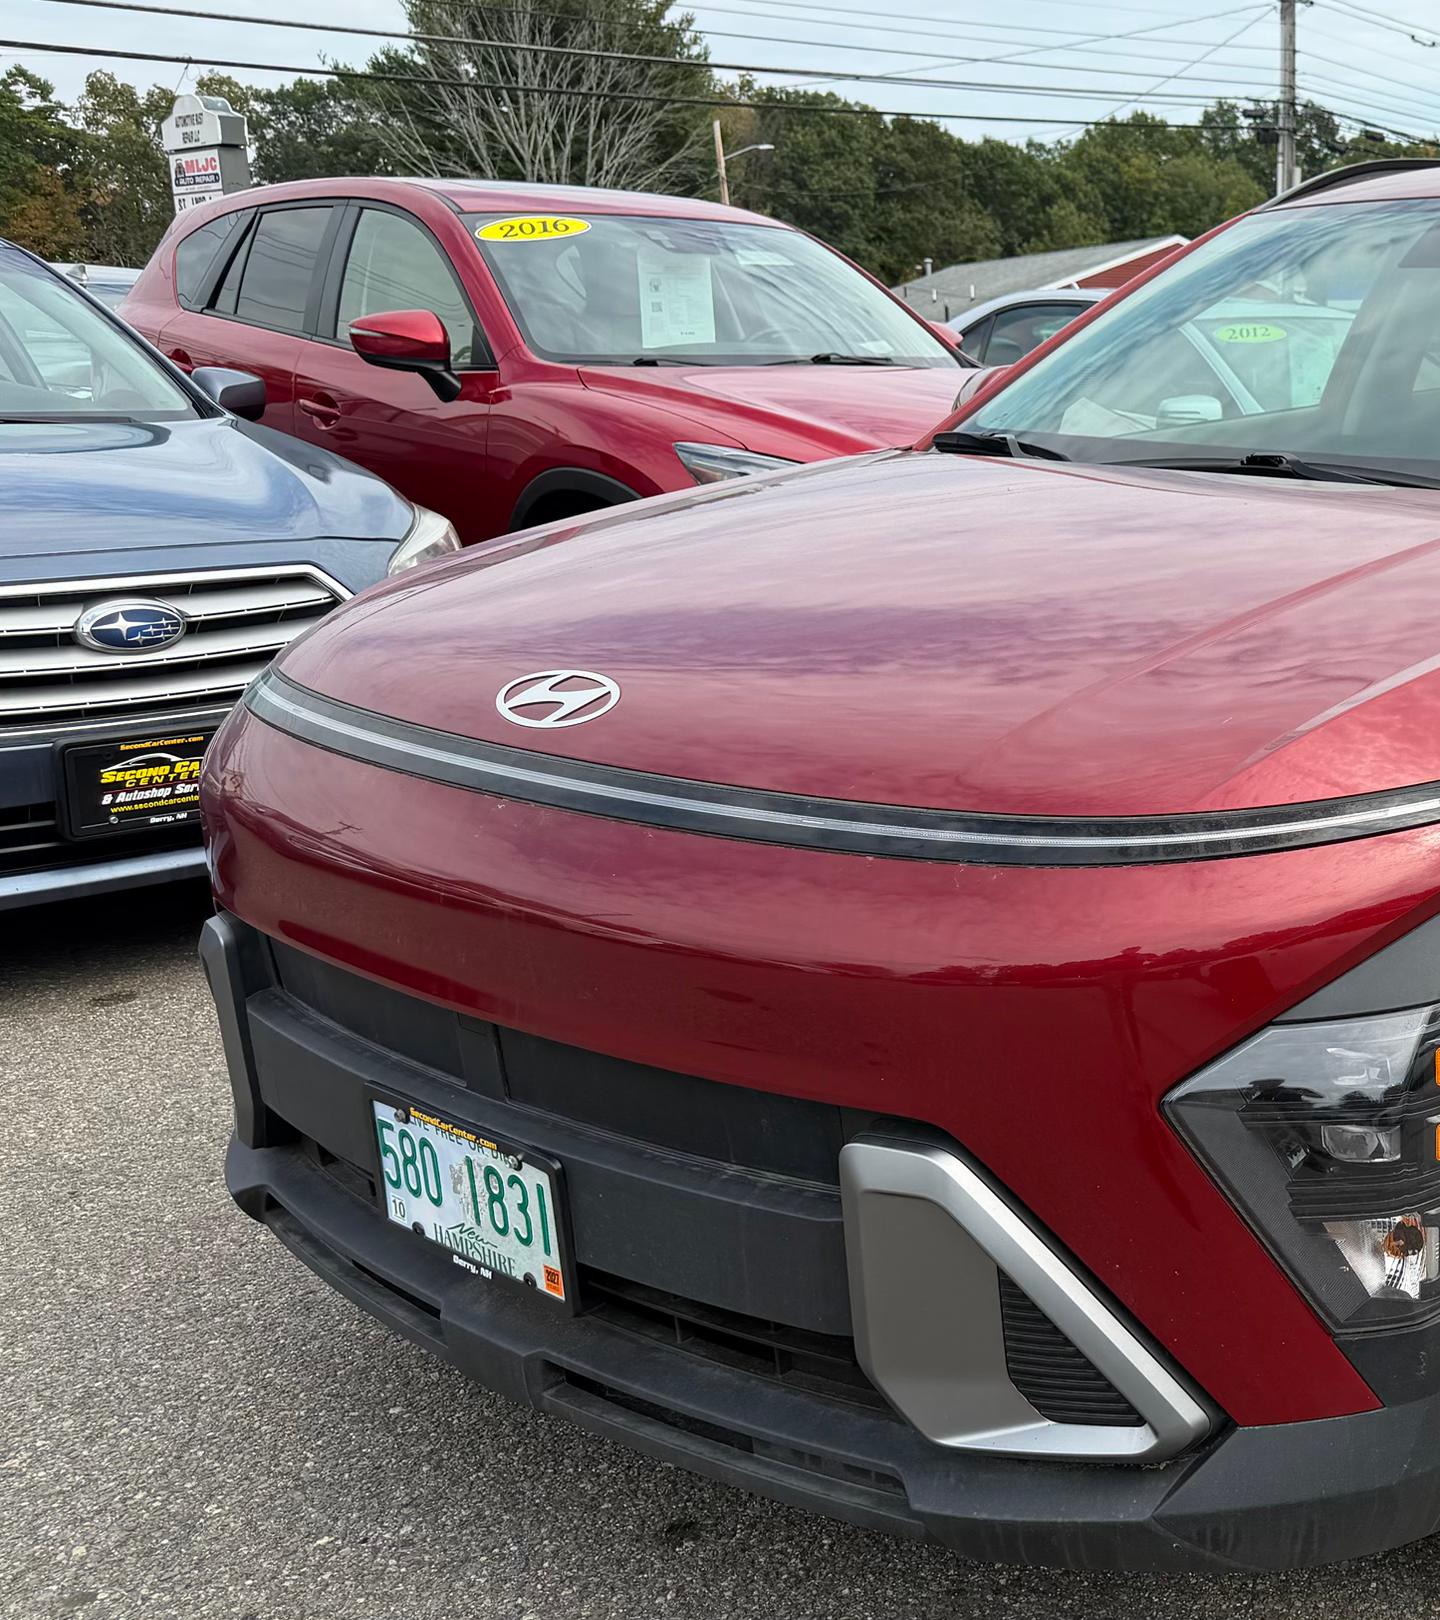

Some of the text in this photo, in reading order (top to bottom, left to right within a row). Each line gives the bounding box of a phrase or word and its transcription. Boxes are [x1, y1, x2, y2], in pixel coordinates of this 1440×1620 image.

[184, 157, 217, 174] MLJC
[195, 175, 216, 184] REPAIR
[499, 218, 570, 239] 2016
[1227, 326, 1271, 340] 2012
[119, 735, 204, 751] SecondCarCenter.com
[174, 760, 200, 773] CA
[101, 792, 114, 805] &
[115, 786, 172, 805] Autoshop
[110, 795, 200, 812] www.secondcarcente
[176, 812, 188, 820] NH
[409, 1107, 498, 1150] SecondCarCenter.com
[377, 1118, 551, 1257] 580 1831
[392, 1198, 406, 1218] 10
[447, 1222, 498, 1249] New
[434, 1223, 518, 1278] HAMPSHIRE
[453, 1254, 493, 1280] Derry, NH
